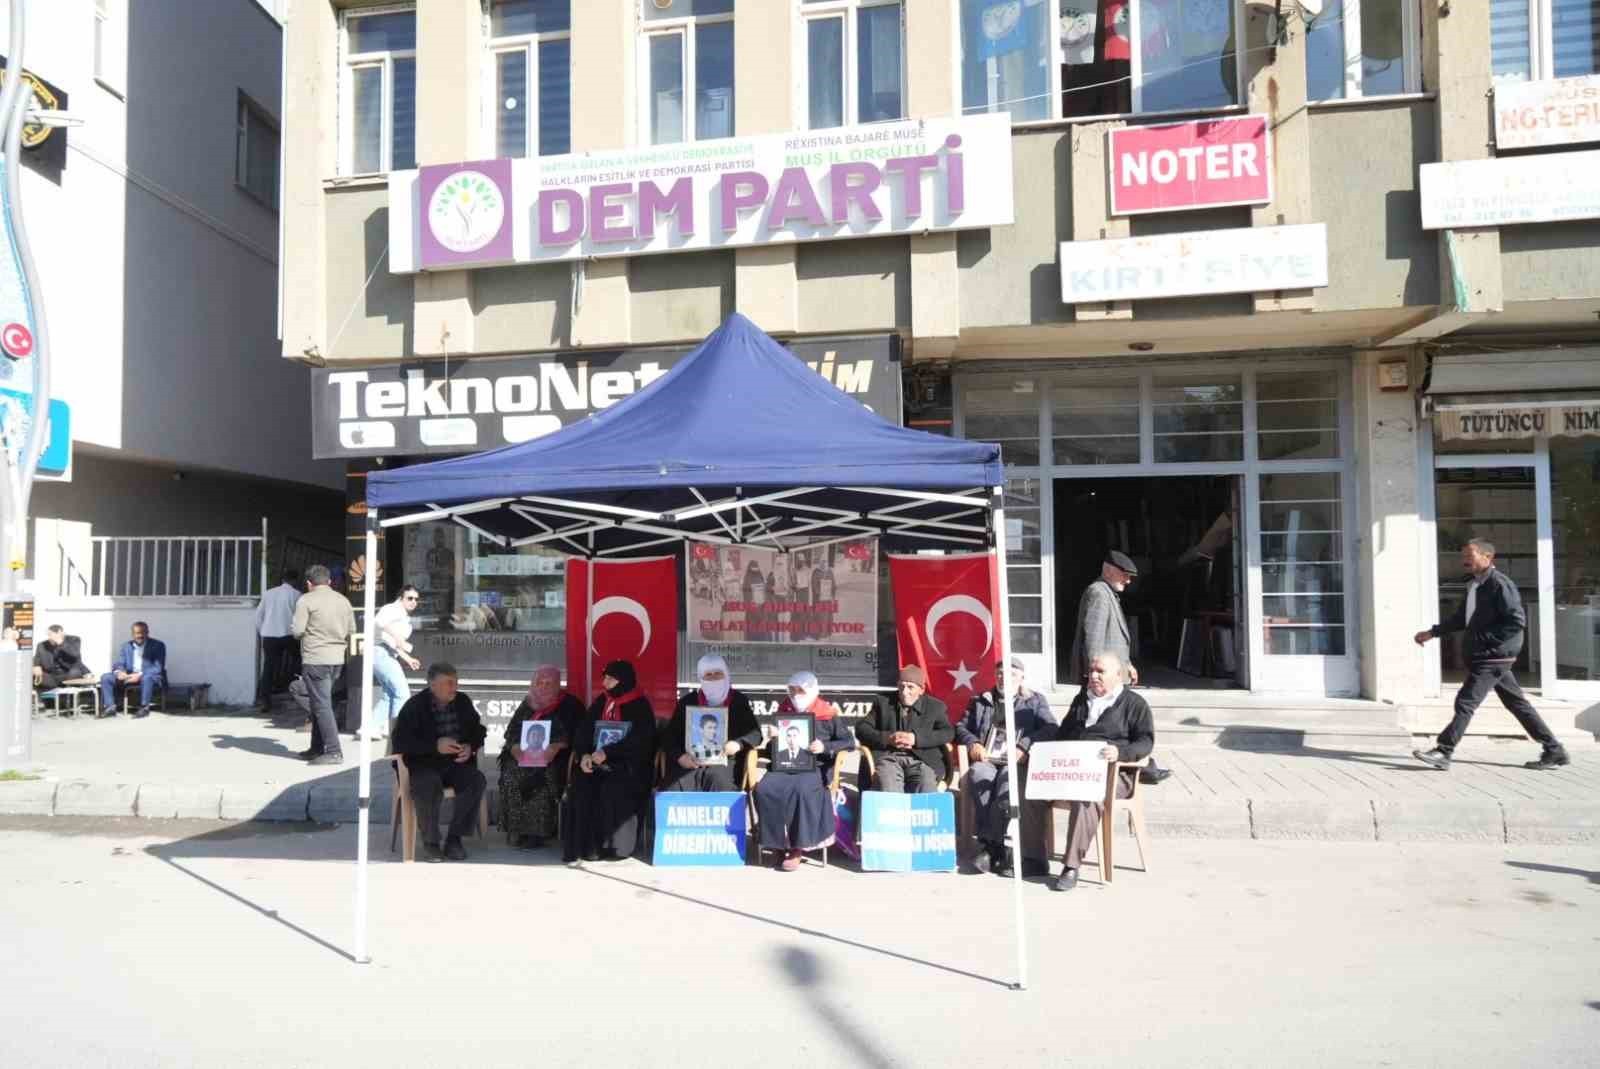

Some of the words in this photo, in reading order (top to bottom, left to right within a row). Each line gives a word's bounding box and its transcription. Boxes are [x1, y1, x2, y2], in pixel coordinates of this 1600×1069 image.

[1121, 142, 1260, 187] NOTER
[538, 176, 694, 246] DEM
[1460, 408, 1545, 432] TÜTÜNCÜ
[1051, 758, 1081, 769] EVLAT
